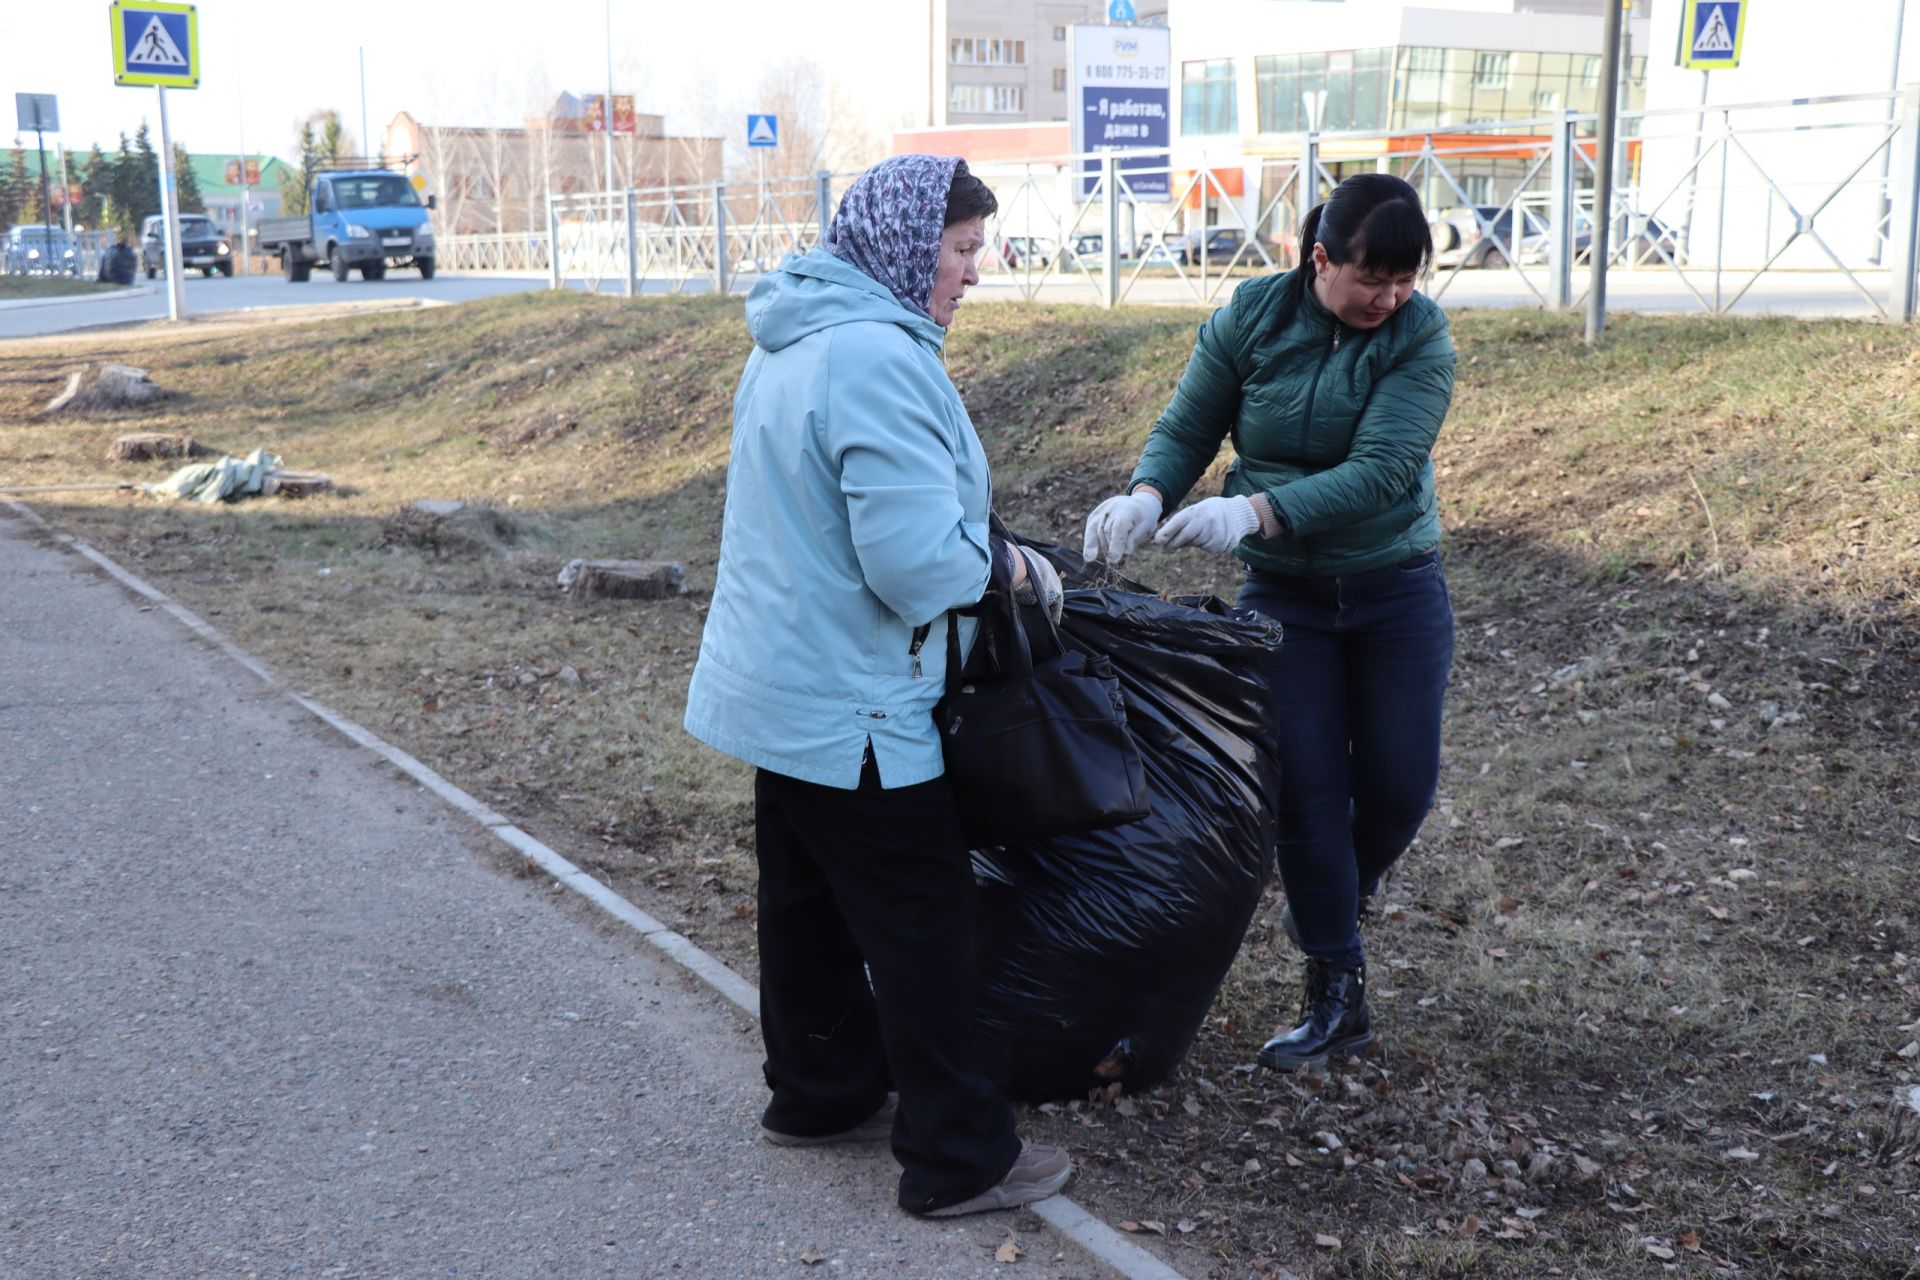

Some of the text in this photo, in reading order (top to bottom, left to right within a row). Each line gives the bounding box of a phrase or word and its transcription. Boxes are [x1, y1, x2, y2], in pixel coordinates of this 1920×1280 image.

[1086, 65, 1165, 79] 8 800 775-35-27
[1099, 98, 1108, 116] Я
[1110, 98, 1166, 120] работаю,
[1104, 123, 1149, 140] даже в
